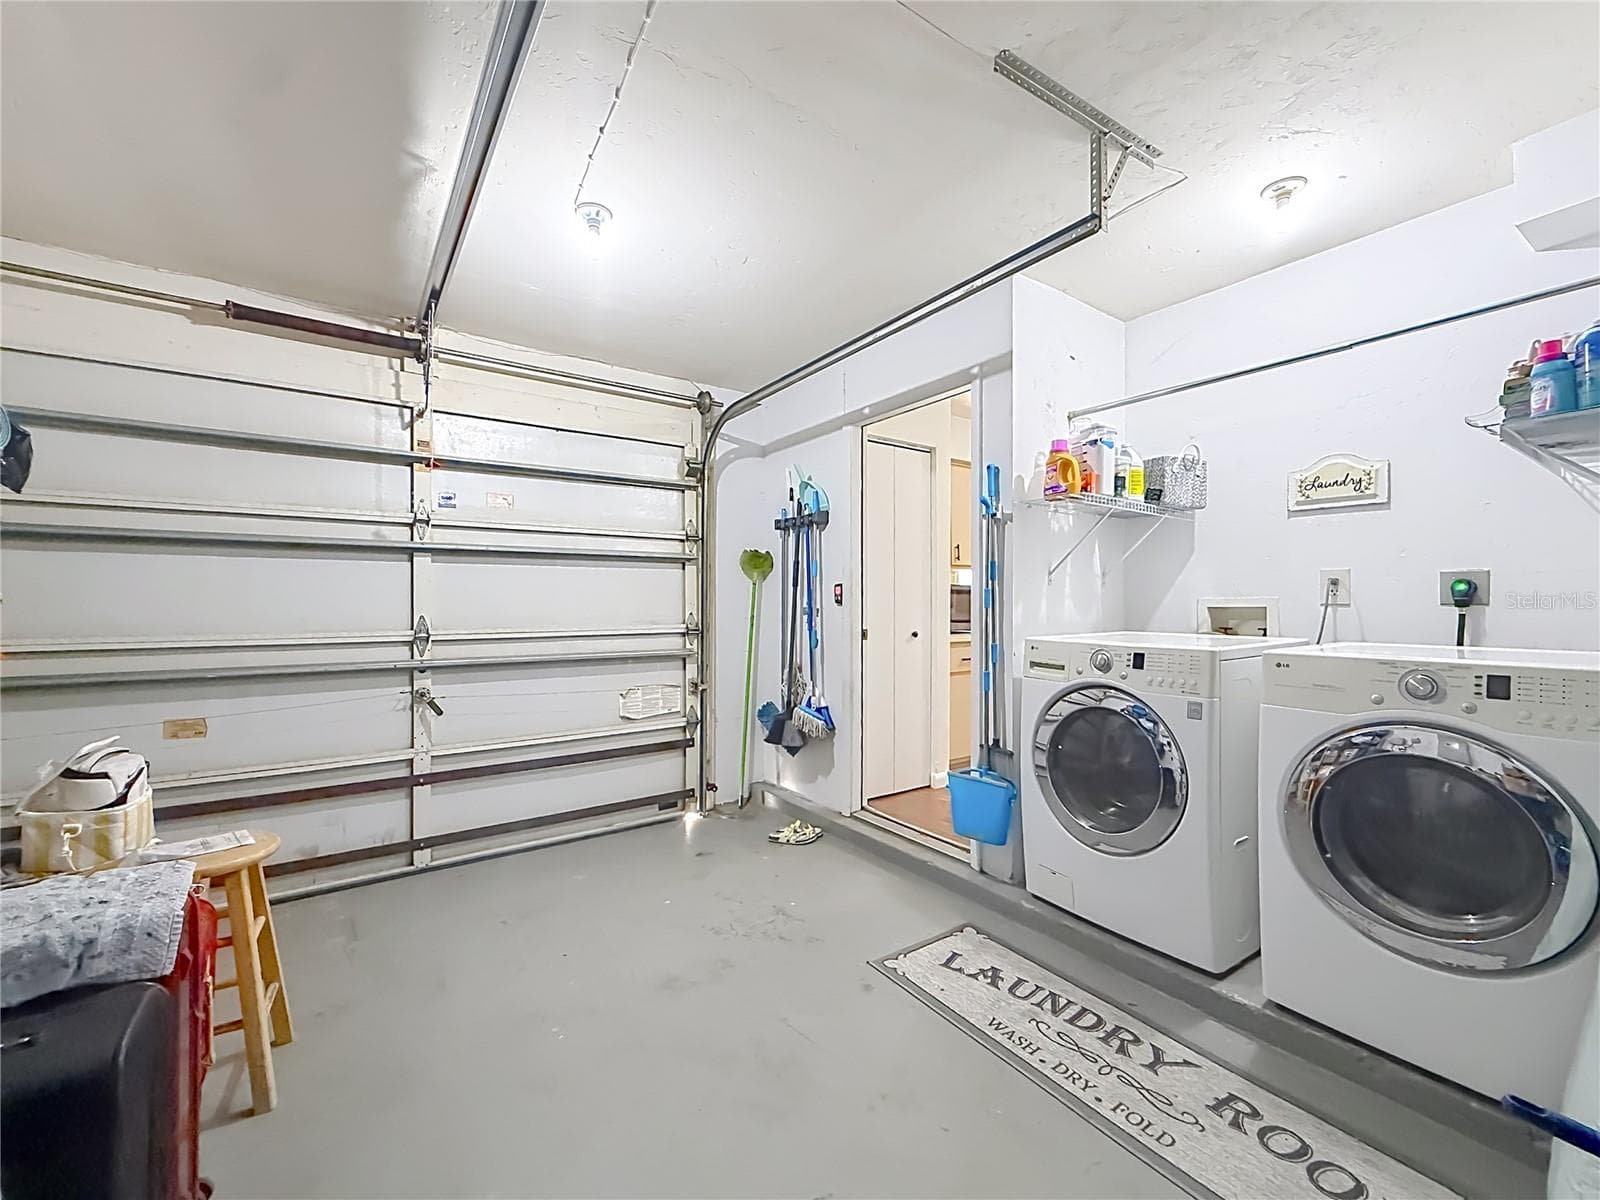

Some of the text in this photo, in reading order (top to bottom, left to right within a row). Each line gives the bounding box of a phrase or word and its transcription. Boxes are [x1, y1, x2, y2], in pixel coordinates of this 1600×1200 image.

[1304, 473, 1362, 492] Laundry
[939, 950, 1387, 1200] LAUNDRY ROO
[987, 1016, 1177, 1148] WASH DRY FOLD
